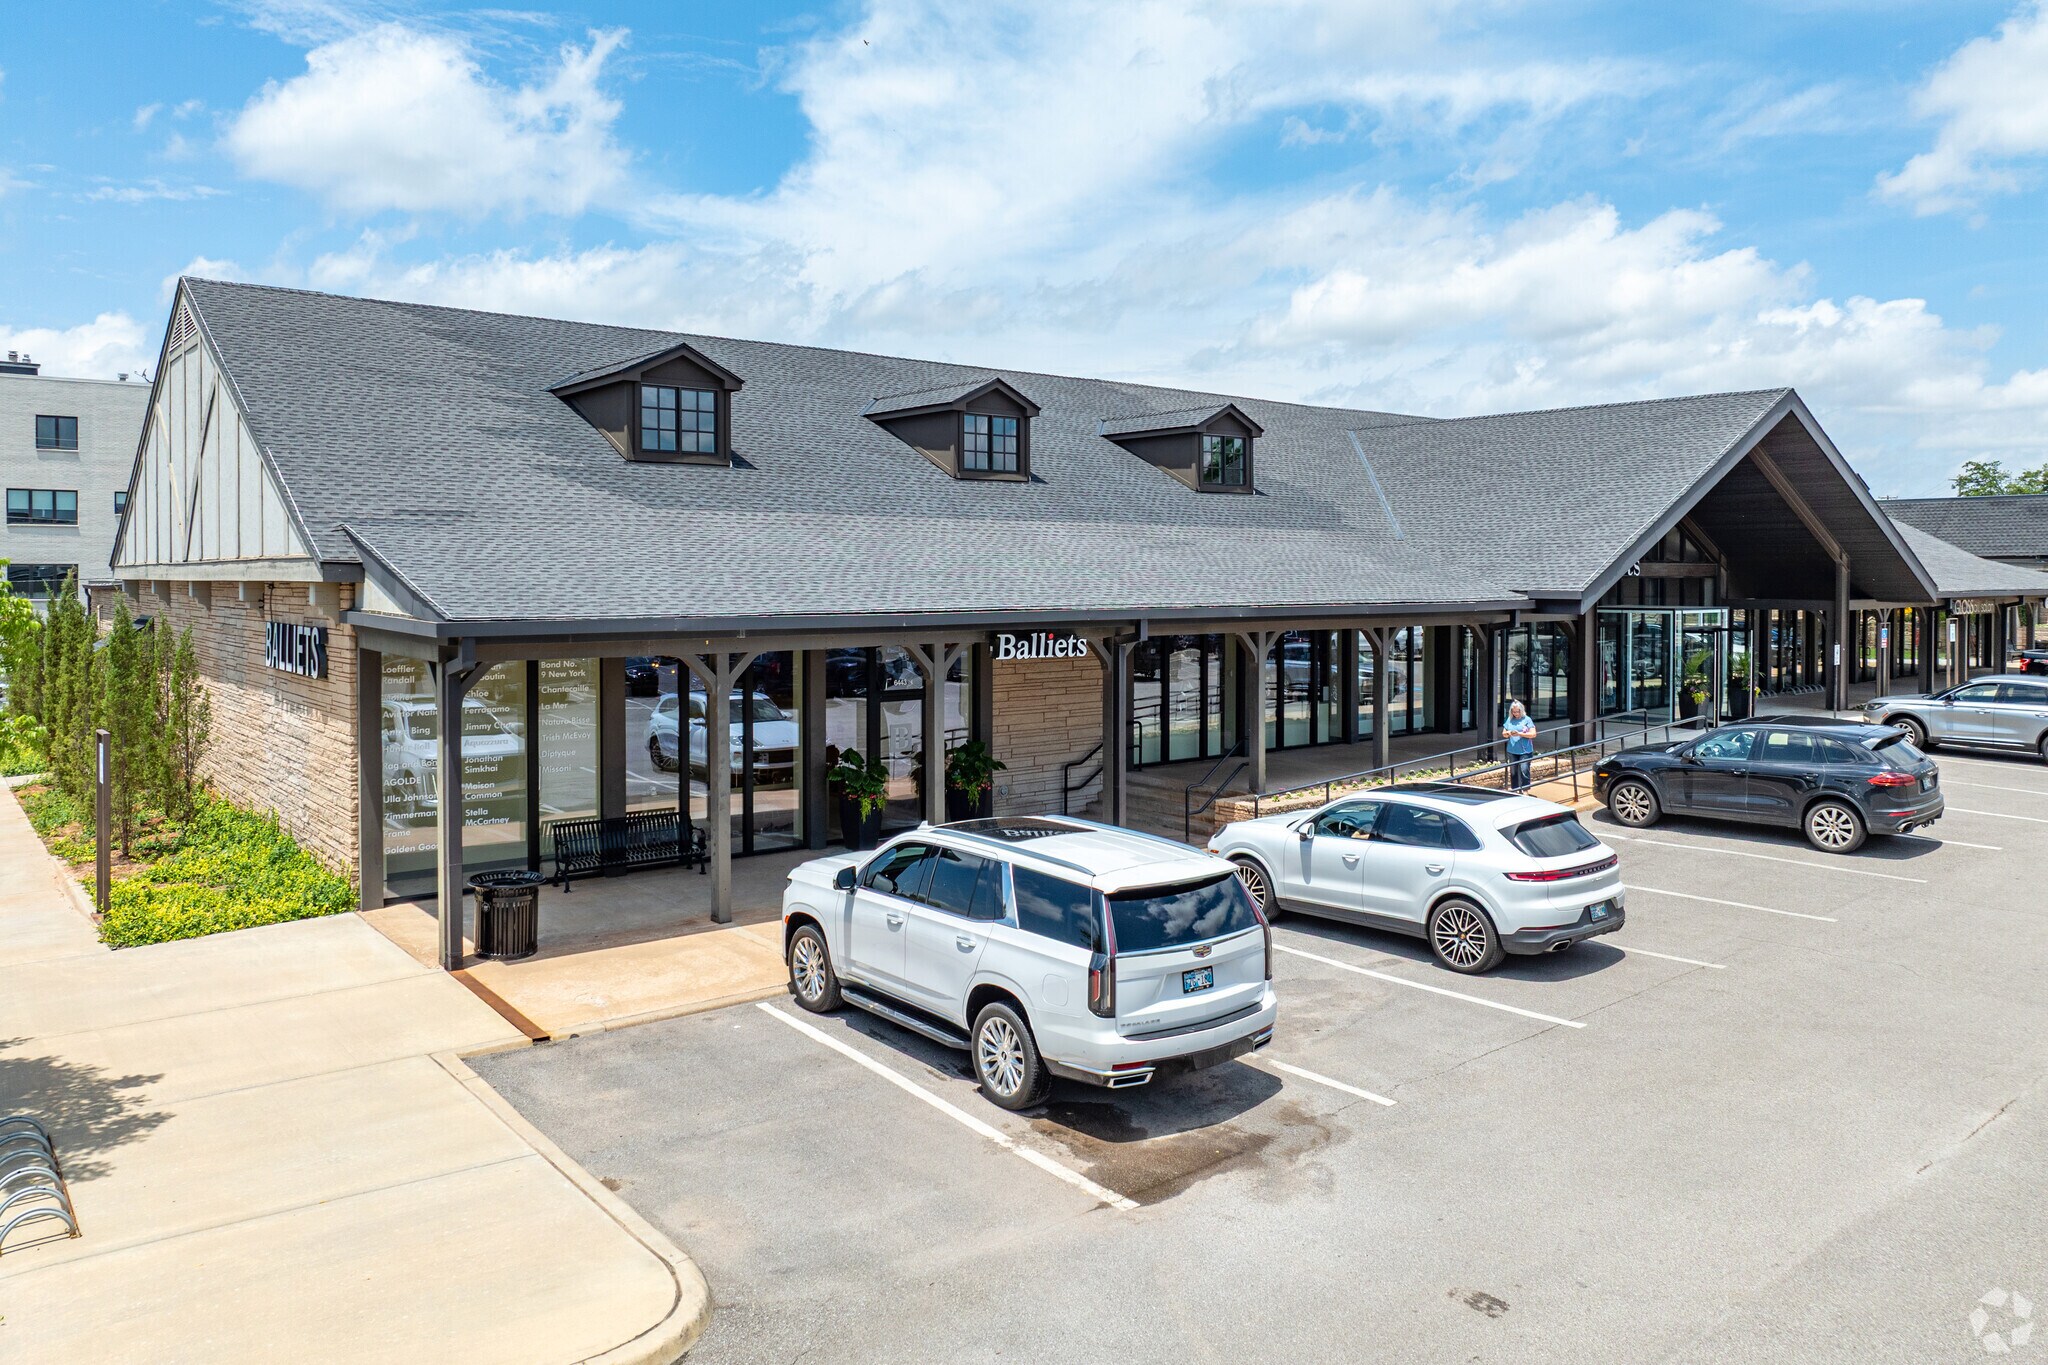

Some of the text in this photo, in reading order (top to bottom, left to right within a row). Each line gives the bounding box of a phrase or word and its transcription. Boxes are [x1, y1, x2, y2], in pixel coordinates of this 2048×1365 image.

[265, 621, 320, 680] BALLIETS
[996, 632, 1088, 660] Balliets
[382, 664, 416, 674] Loeffler
[541, 660, 577, 669] Bond No.
[479, 672, 506, 680] outin
[541, 669, 586, 679] 9 New York
[893, 678, 908, 687] 6443
[541, 684, 590, 694] Chantecaille
[464, 705, 511, 715] Ferragamo
[541, 702, 569, 711] La Mer
[411, 726, 431, 736] Bing
[464, 722, 492, 732] Jimmy
[562, 731, 592, 740] McEvoy
[421, 759, 438, 768] Bon
[464, 755, 504, 764] Jonathan
[464, 764, 499, 774] Simkhai
[383, 777, 422, 787] AGOLDE
[464, 781, 495, 790] Maison
[383, 794, 401, 804] Ulla
[464, 791, 503, 800] Common
[465, 808, 489, 817] Stella
[465, 817, 510, 827] McCartney
[383, 829, 411, 838] Frame
[384, 843, 438, 855] Golden Goo
